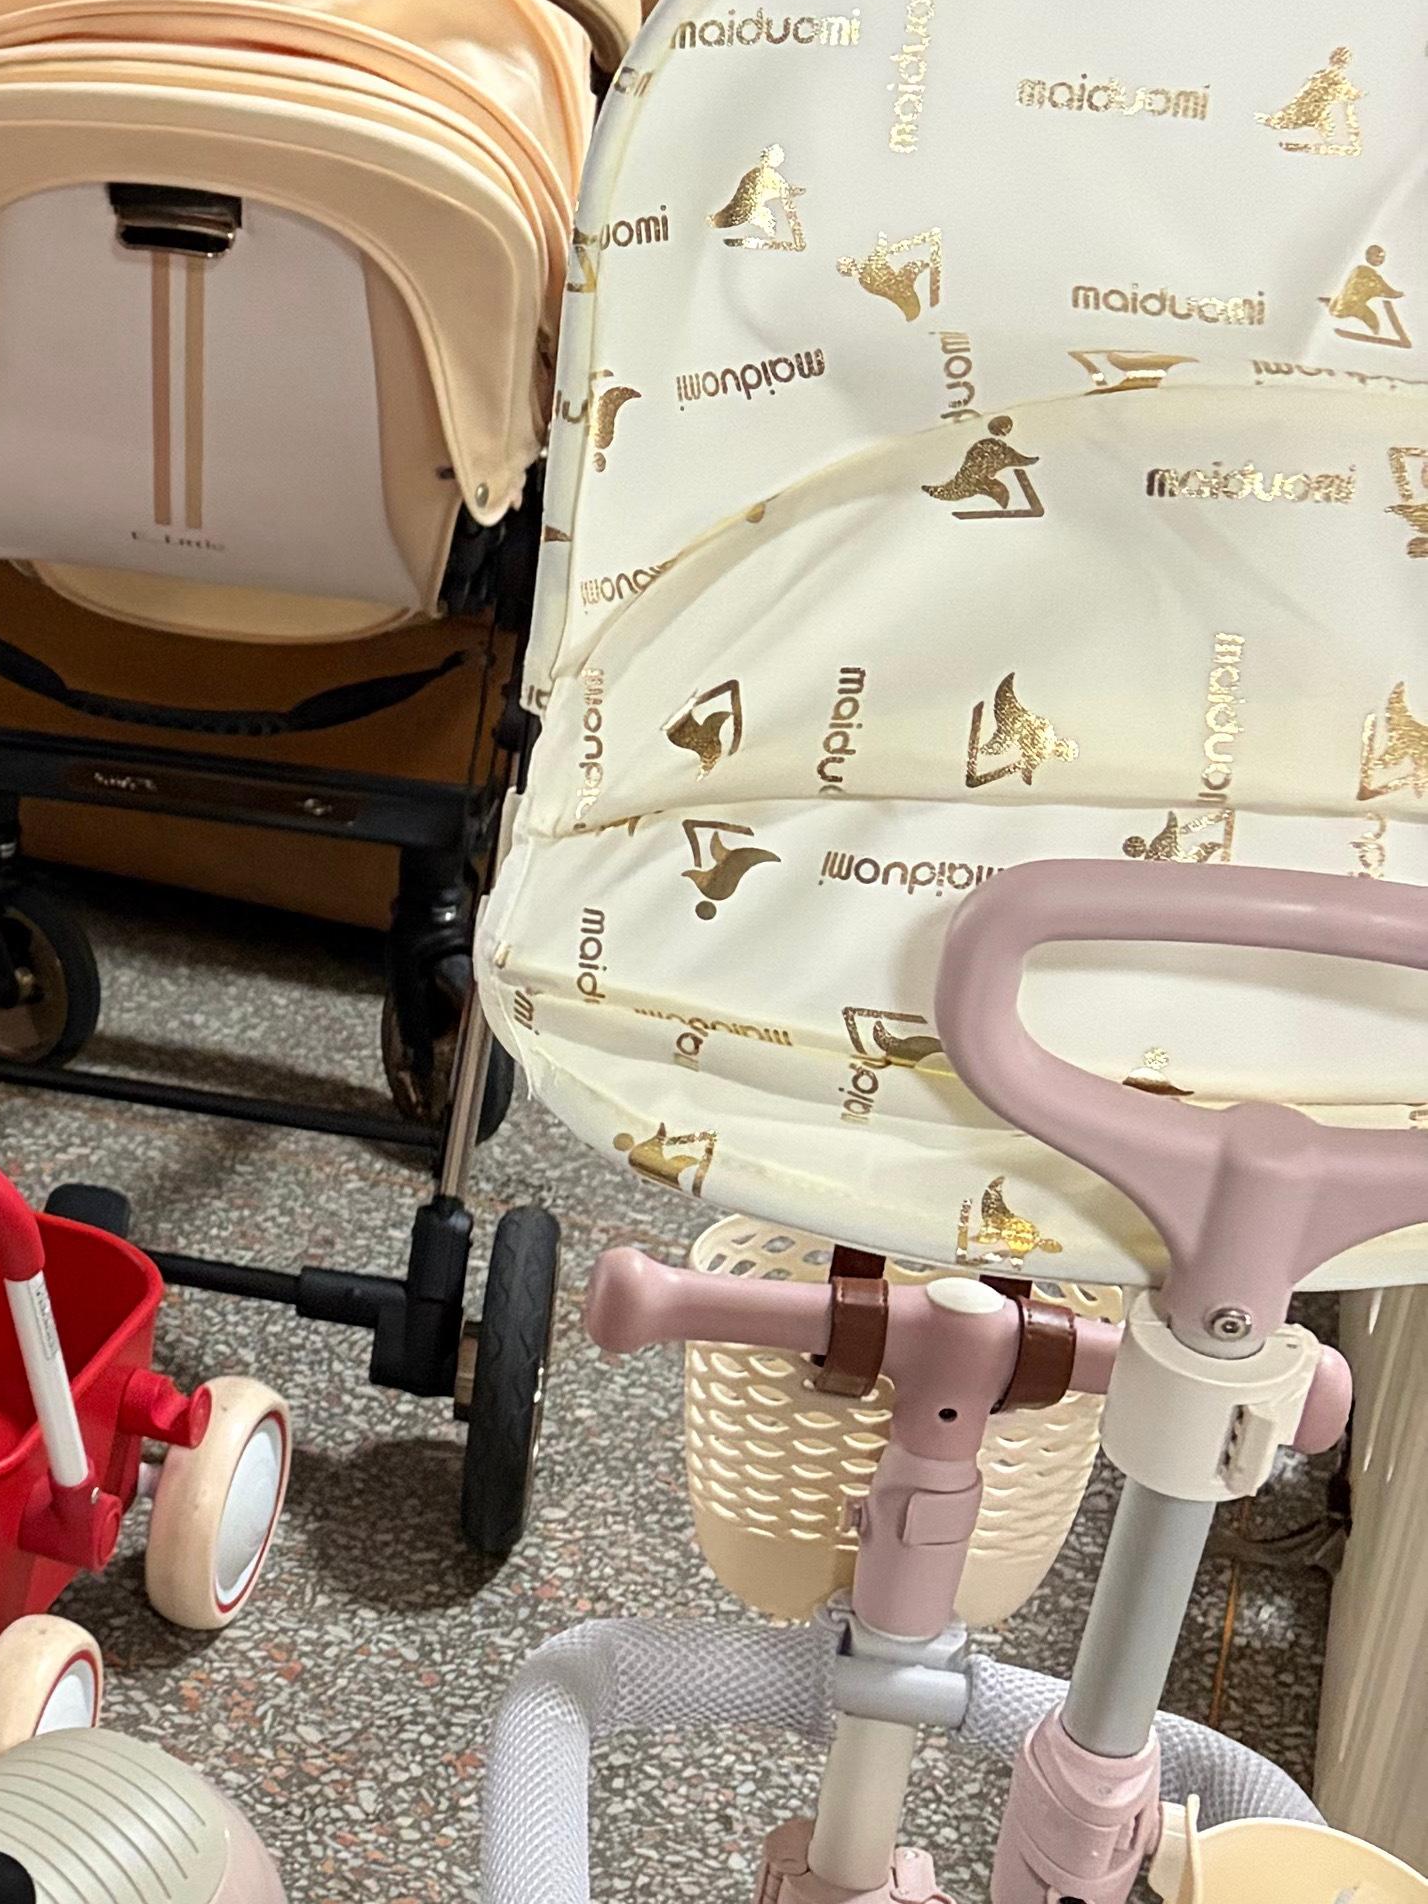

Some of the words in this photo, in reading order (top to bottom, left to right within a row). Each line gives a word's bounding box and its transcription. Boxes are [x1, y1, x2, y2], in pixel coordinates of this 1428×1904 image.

[670, 7, 862, 49] maiduomi
[1016, 72, 1210, 121] maiduomi
[599, 204, 669, 251] uomi
[1072, 282, 1266, 326] maiduomi
[676, 347, 826, 412] maiduomi
[929, 330, 982, 423] uomi
[1145, 460, 1357, 504] maiduomi
[817, 666, 866, 794] maidu
[1197, 632, 1246, 803] maiduo
